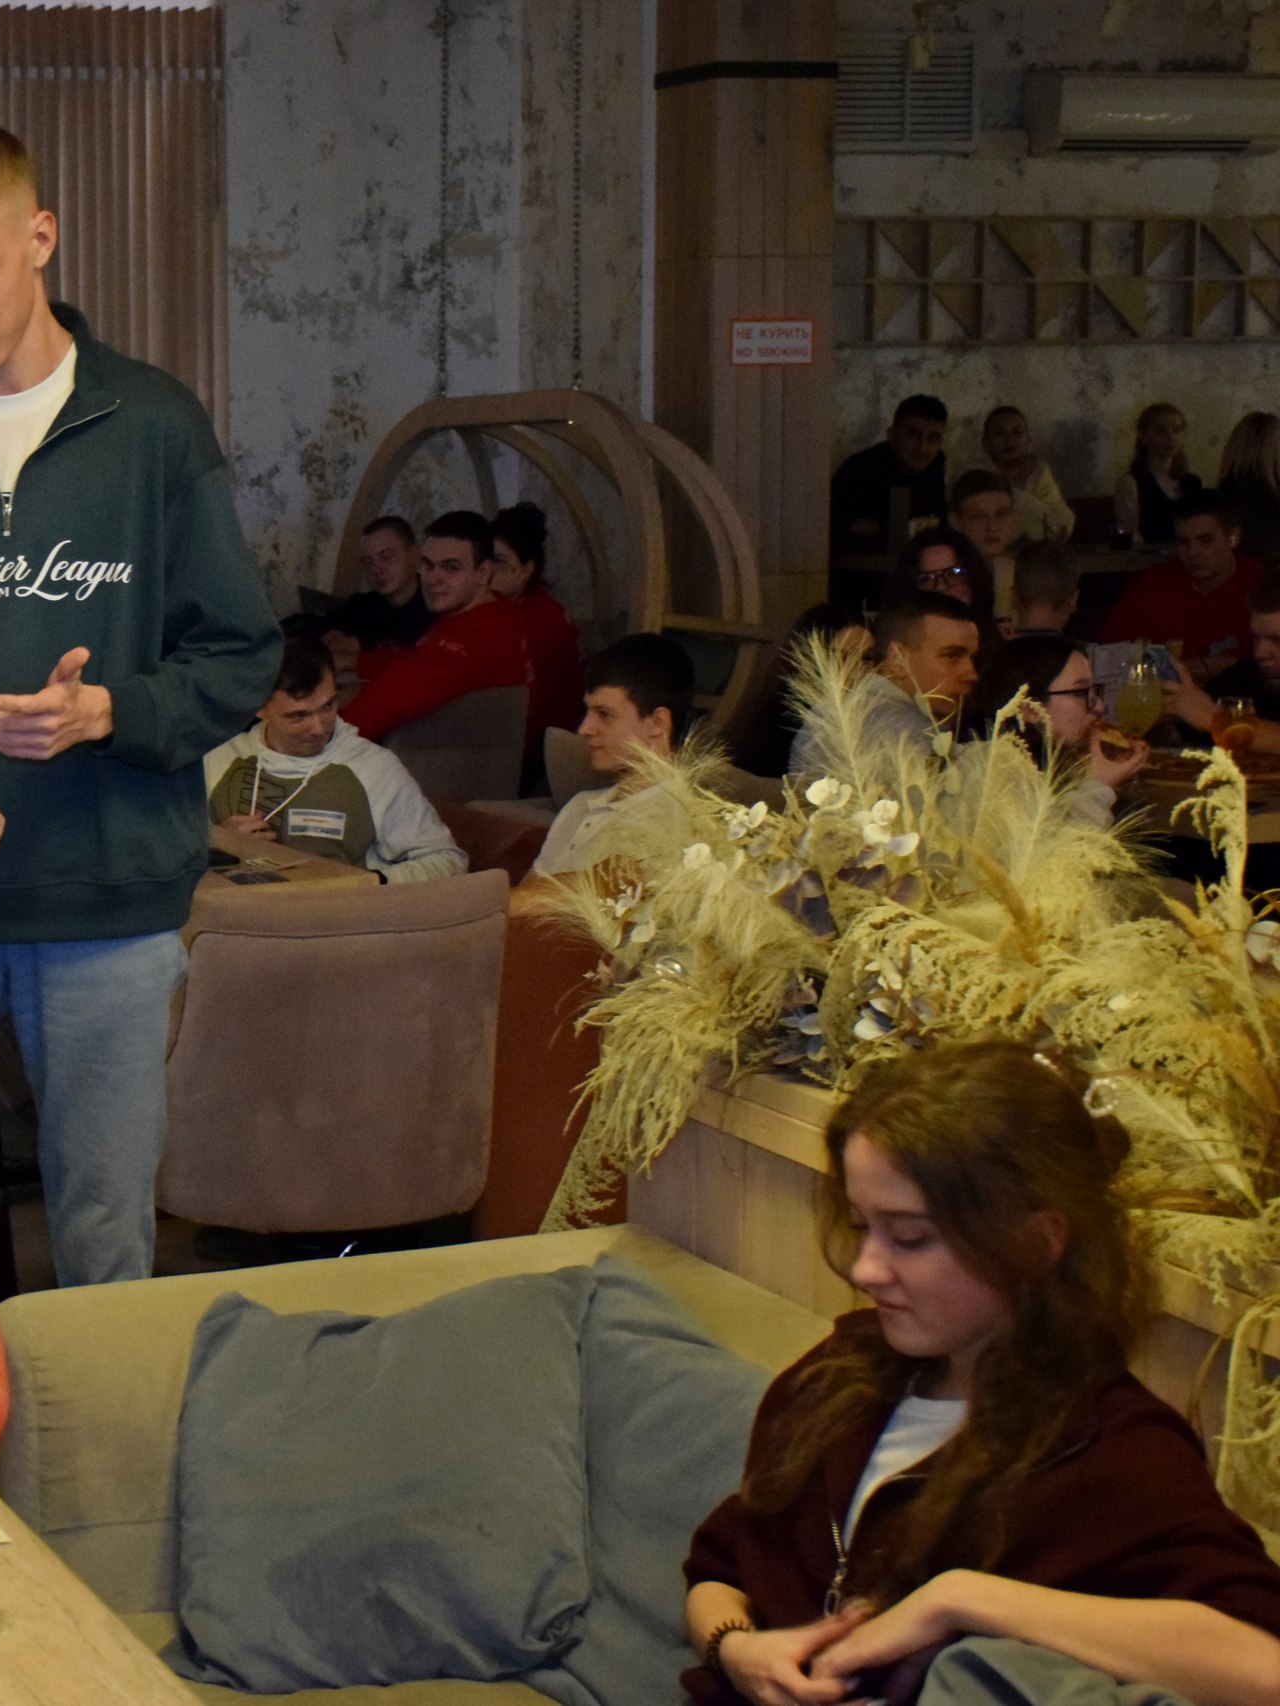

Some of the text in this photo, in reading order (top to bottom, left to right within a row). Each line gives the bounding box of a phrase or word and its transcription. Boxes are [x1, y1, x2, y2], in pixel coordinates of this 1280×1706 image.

[736, 328, 808, 339] НЕ КУРИТЬ
[736, 347, 809, 357] NO SMOKING
